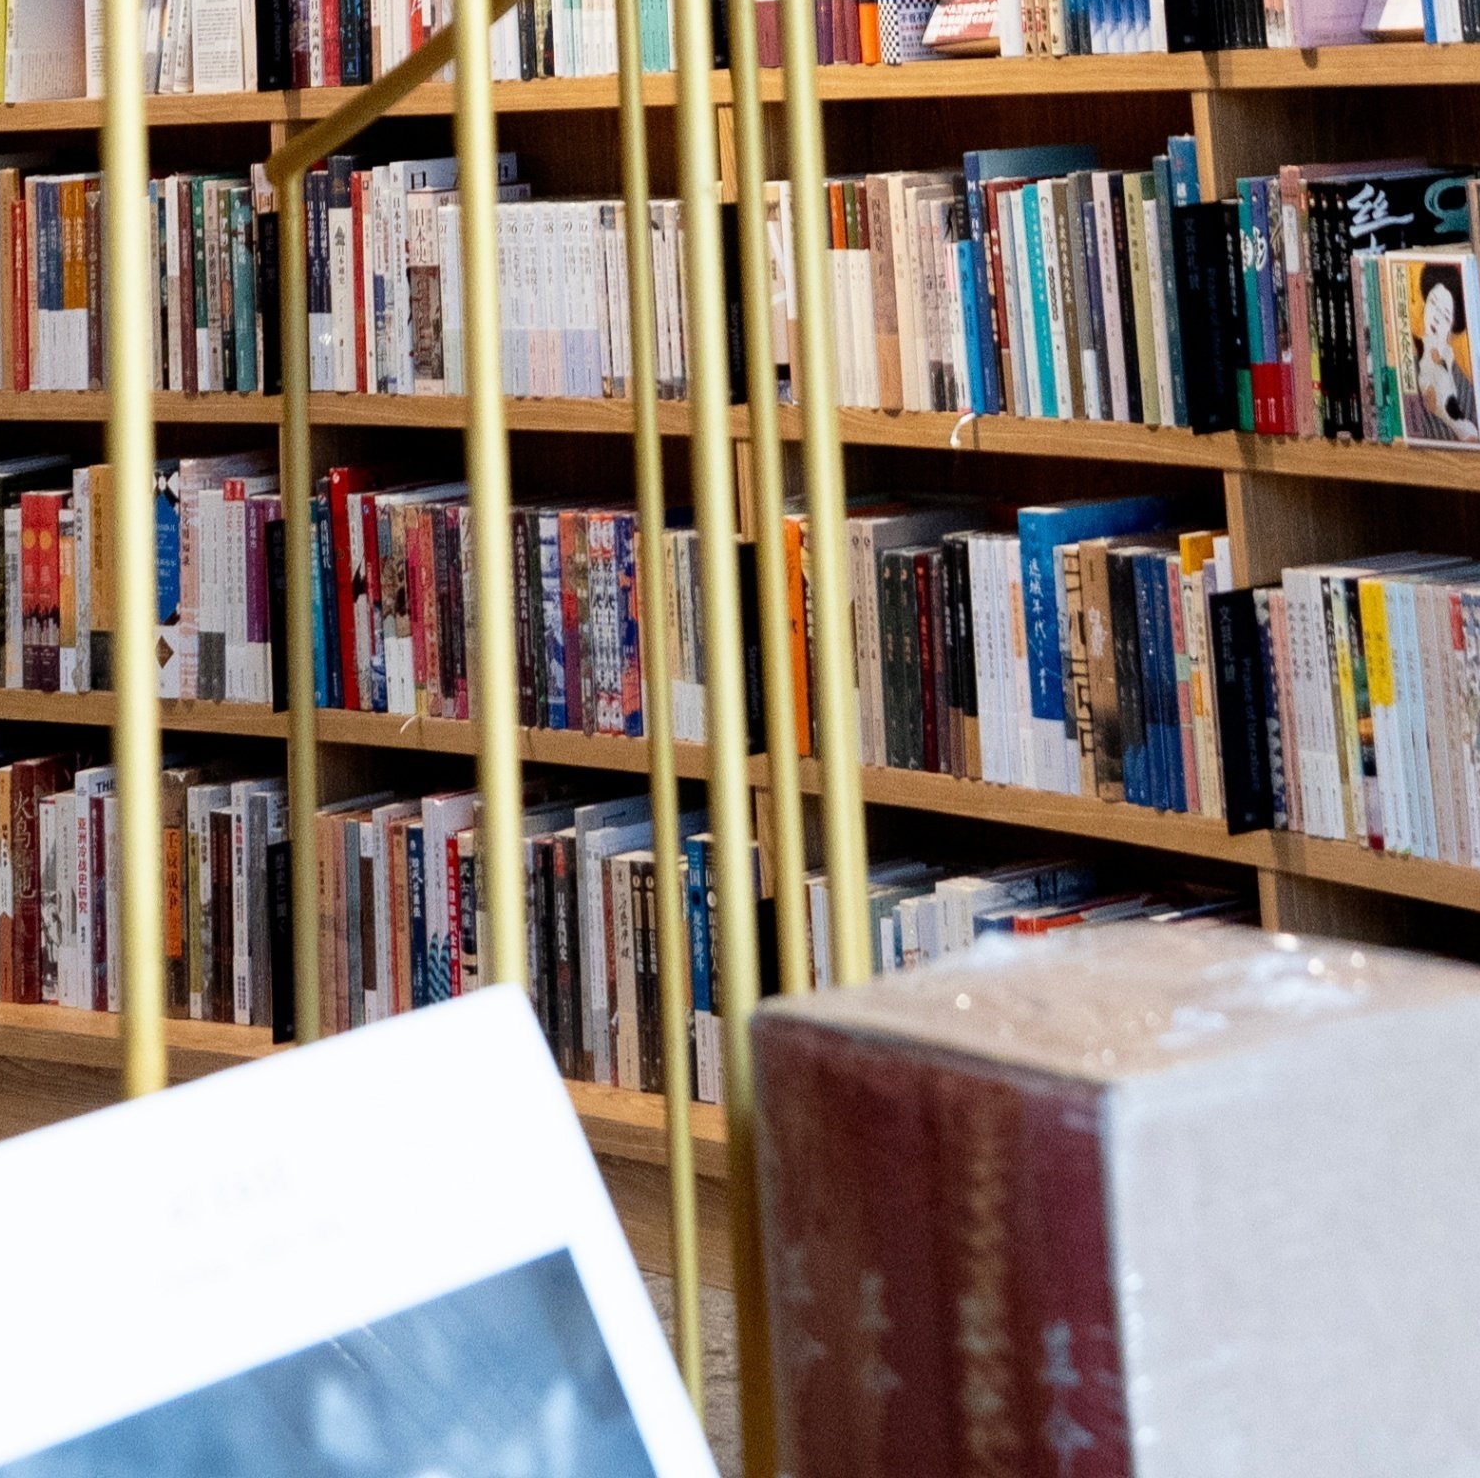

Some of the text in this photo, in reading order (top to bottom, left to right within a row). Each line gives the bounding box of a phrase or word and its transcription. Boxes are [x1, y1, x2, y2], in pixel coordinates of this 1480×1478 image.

[415, 208, 427, 264] 日本史
[76, 816, 88, 915] 亚洲冷战史研究
